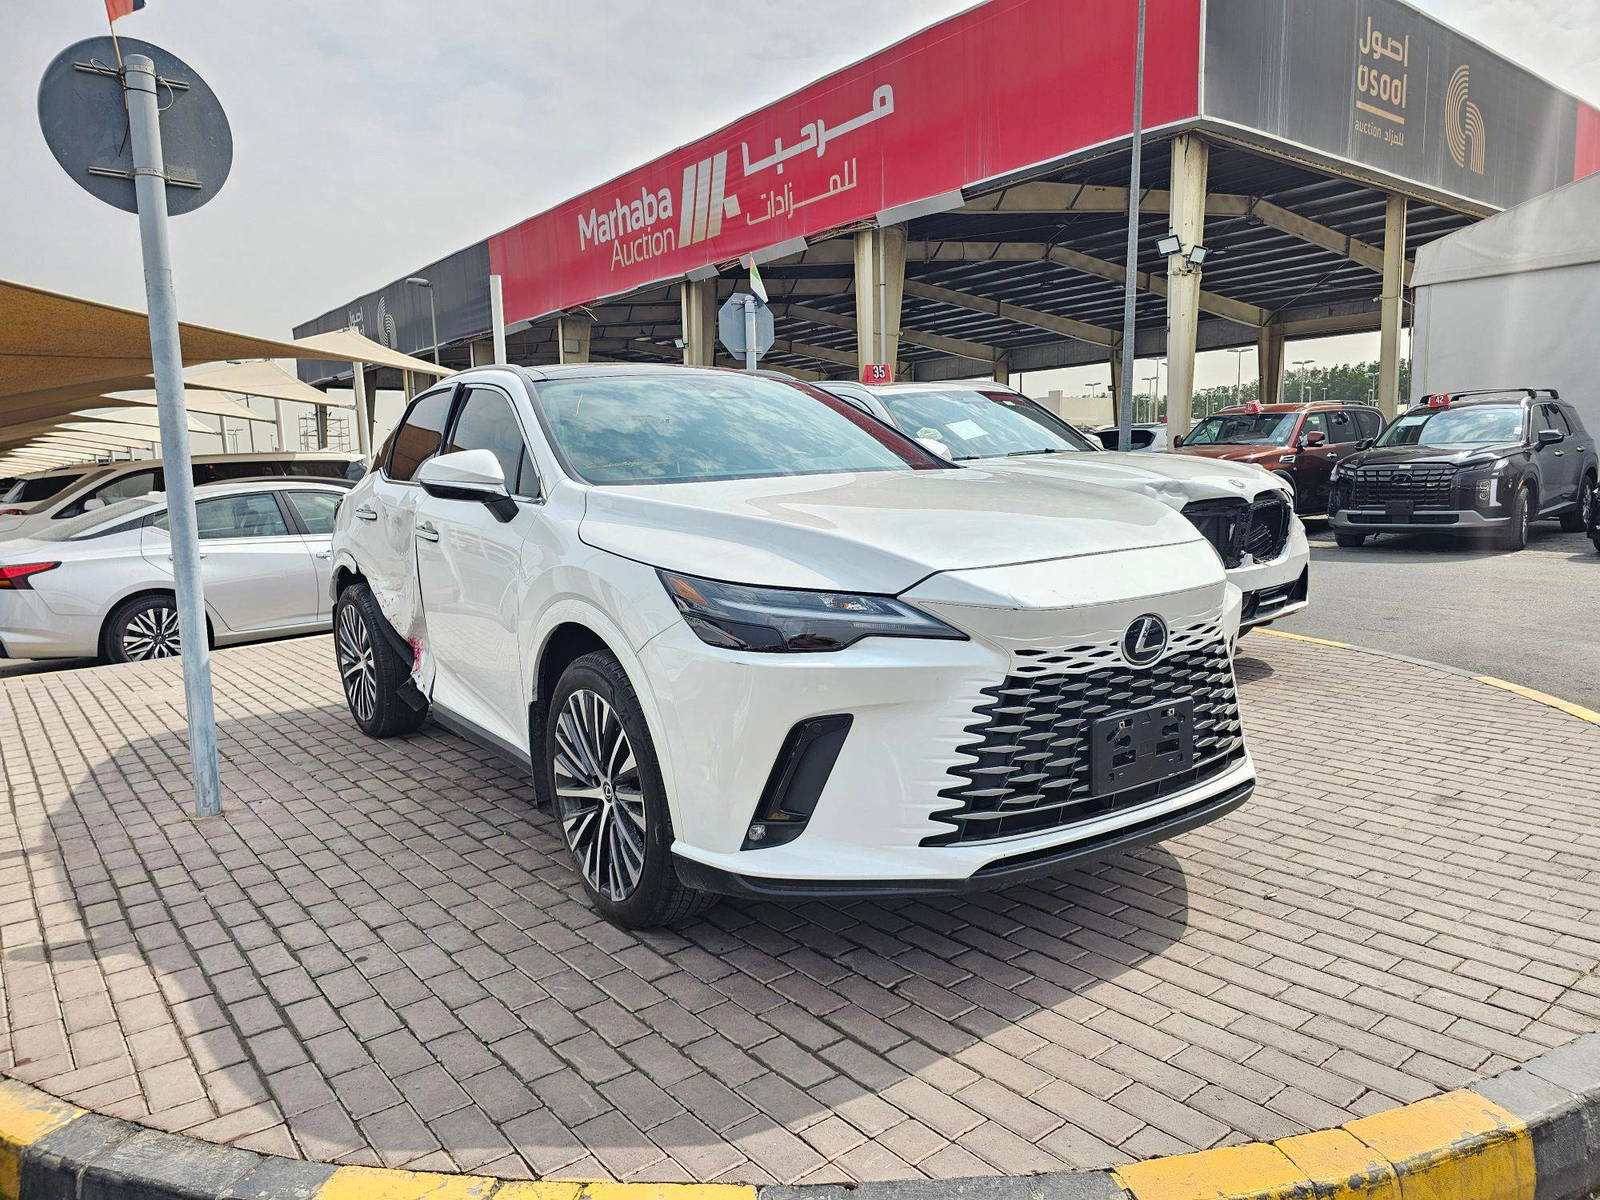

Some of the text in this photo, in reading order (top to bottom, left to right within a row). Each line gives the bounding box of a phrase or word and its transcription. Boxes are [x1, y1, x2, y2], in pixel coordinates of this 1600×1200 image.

[741, 83, 894, 176] مرحبا
[1355, 120, 1381, 138] auction
[578, 185, 673, 251] Marhaba
[610, 227, 674, 271] Auction
[873, 365, 886, 378] 35
